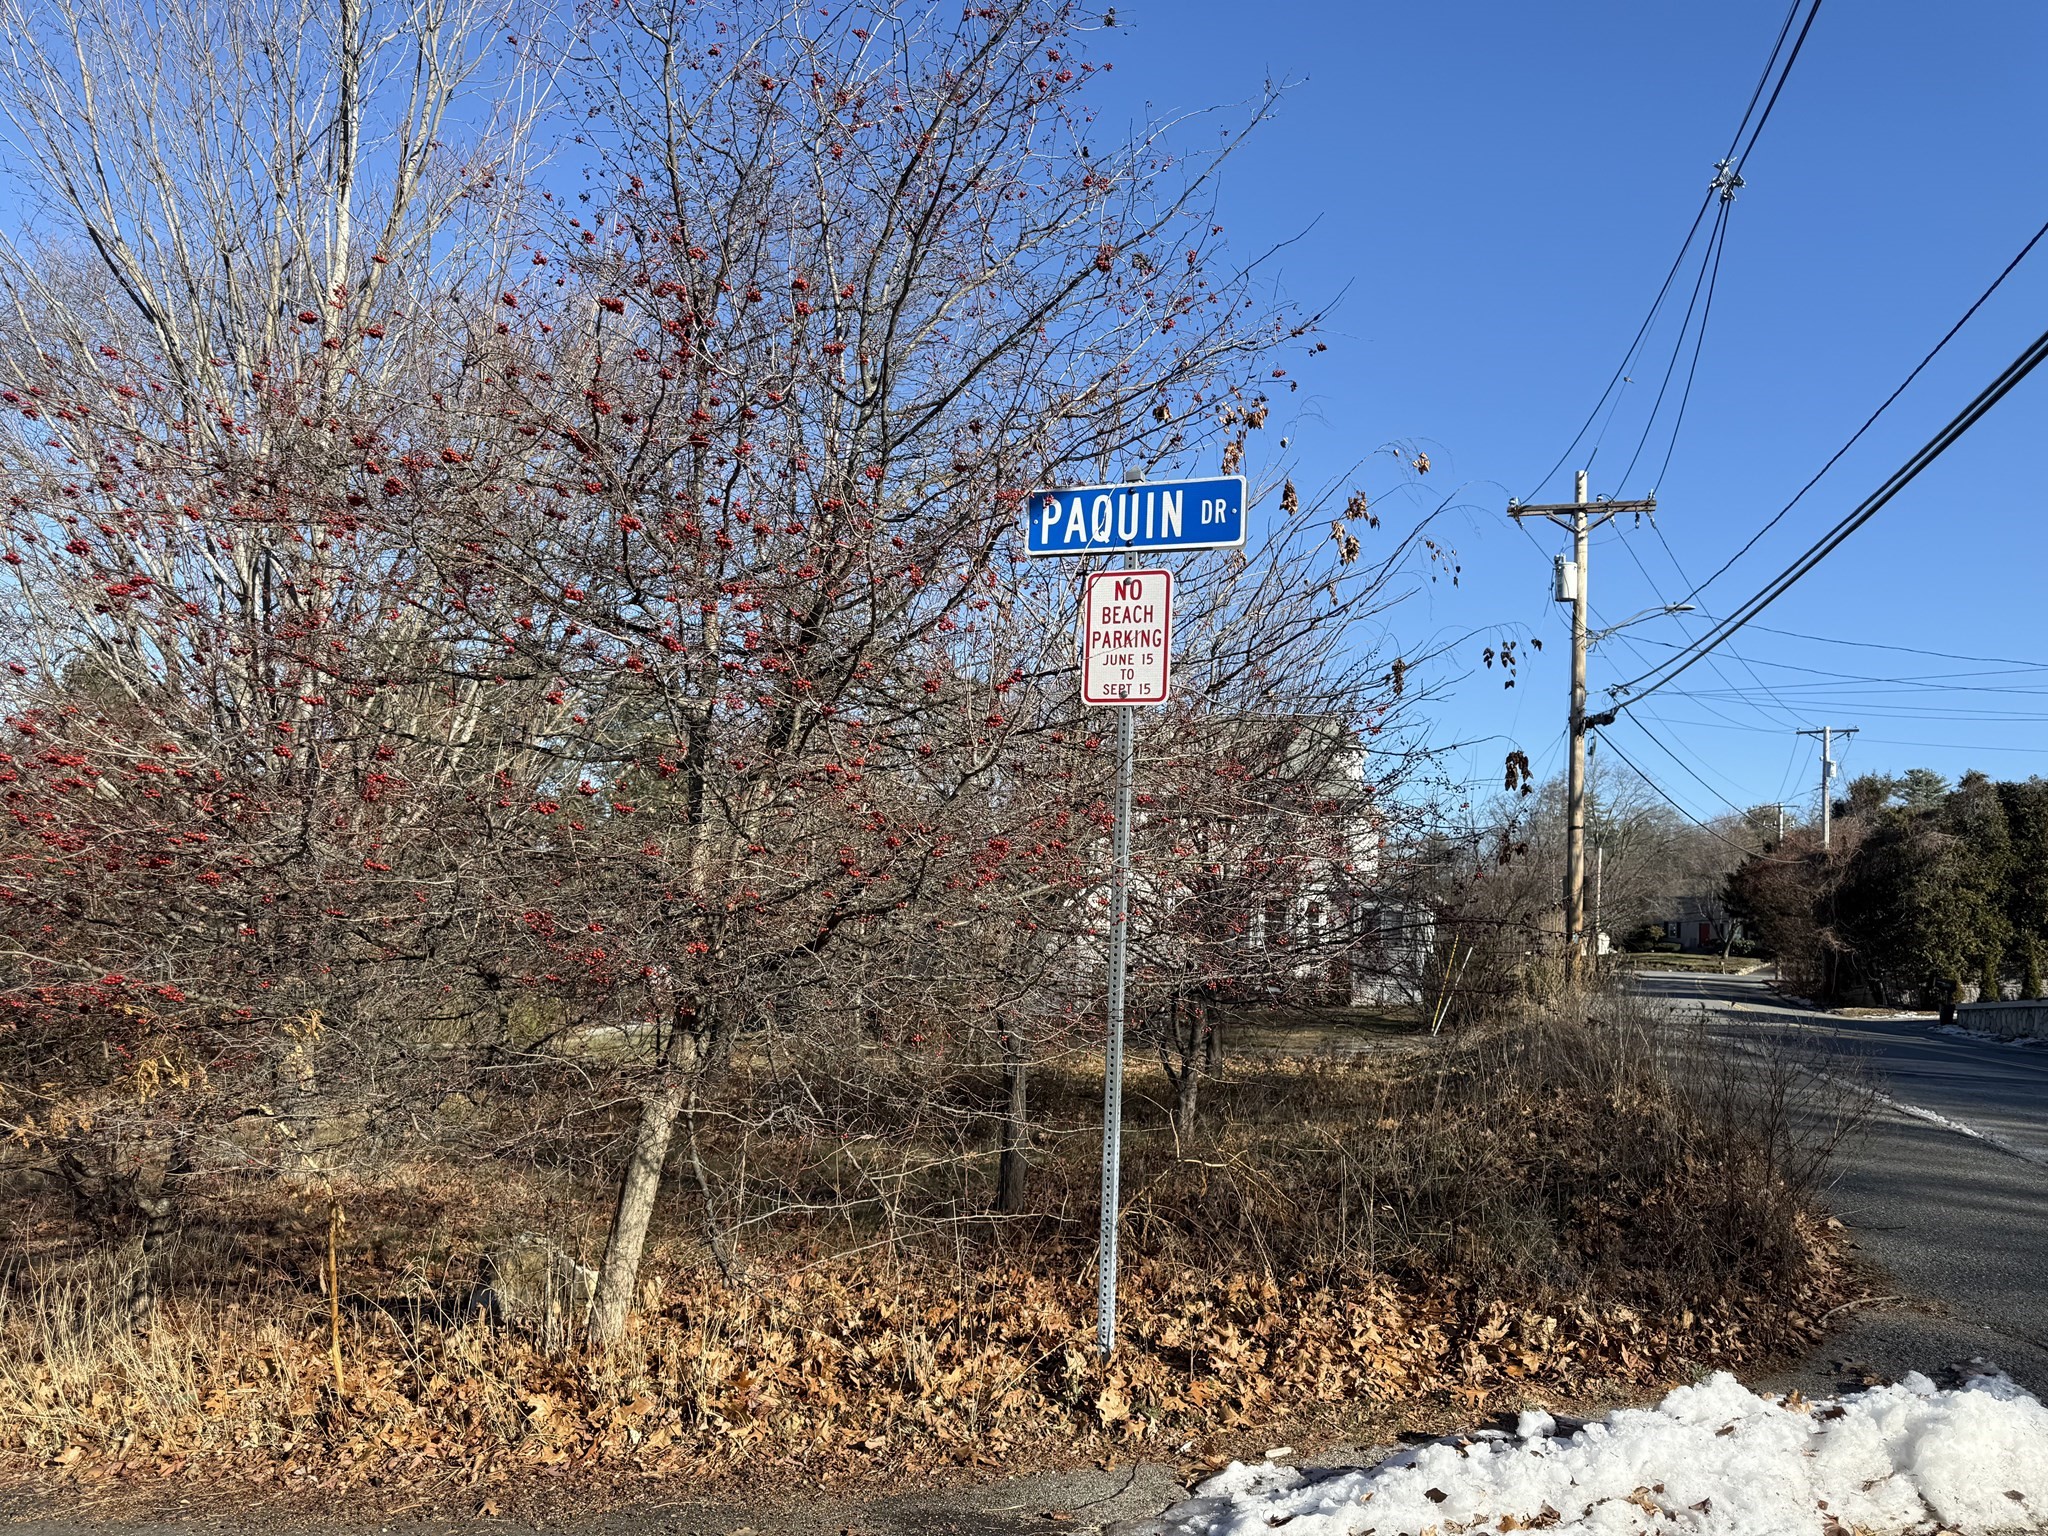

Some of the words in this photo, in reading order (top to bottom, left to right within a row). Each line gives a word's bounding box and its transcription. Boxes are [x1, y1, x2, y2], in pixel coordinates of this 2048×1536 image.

[1041, 490, 1183, 544] PAQUIN
[1201, 499, 1227, 524] DR
[1115, 579, 1142, 601] NO
[1102, 605, 1154, 624] BEACH
[1092, 629, 1162, 649] PARKING
[1103, 654, 1135, 666] JUNE
[1142, 653, 1154, 665] 15
[1121, 669, 1135, 680] TO
[1103, 683, 1132, 695] SEPT
[1139, 683, 1151, 695] 15
